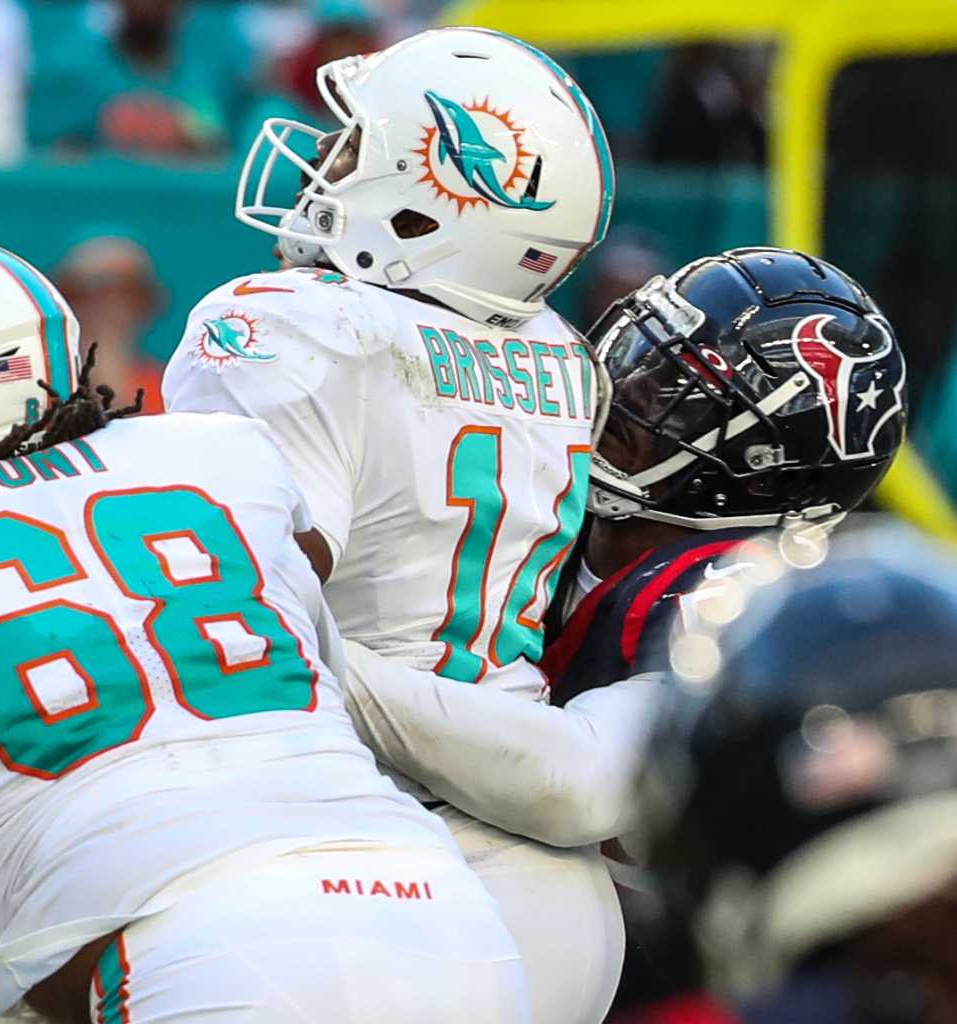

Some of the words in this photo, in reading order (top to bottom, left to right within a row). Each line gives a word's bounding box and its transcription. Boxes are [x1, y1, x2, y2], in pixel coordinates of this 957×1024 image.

[416, 323, 593, 421] BRISSETT
[431, 424, 593, 684] 14
[321, 878, 432, 900] MIAMI
